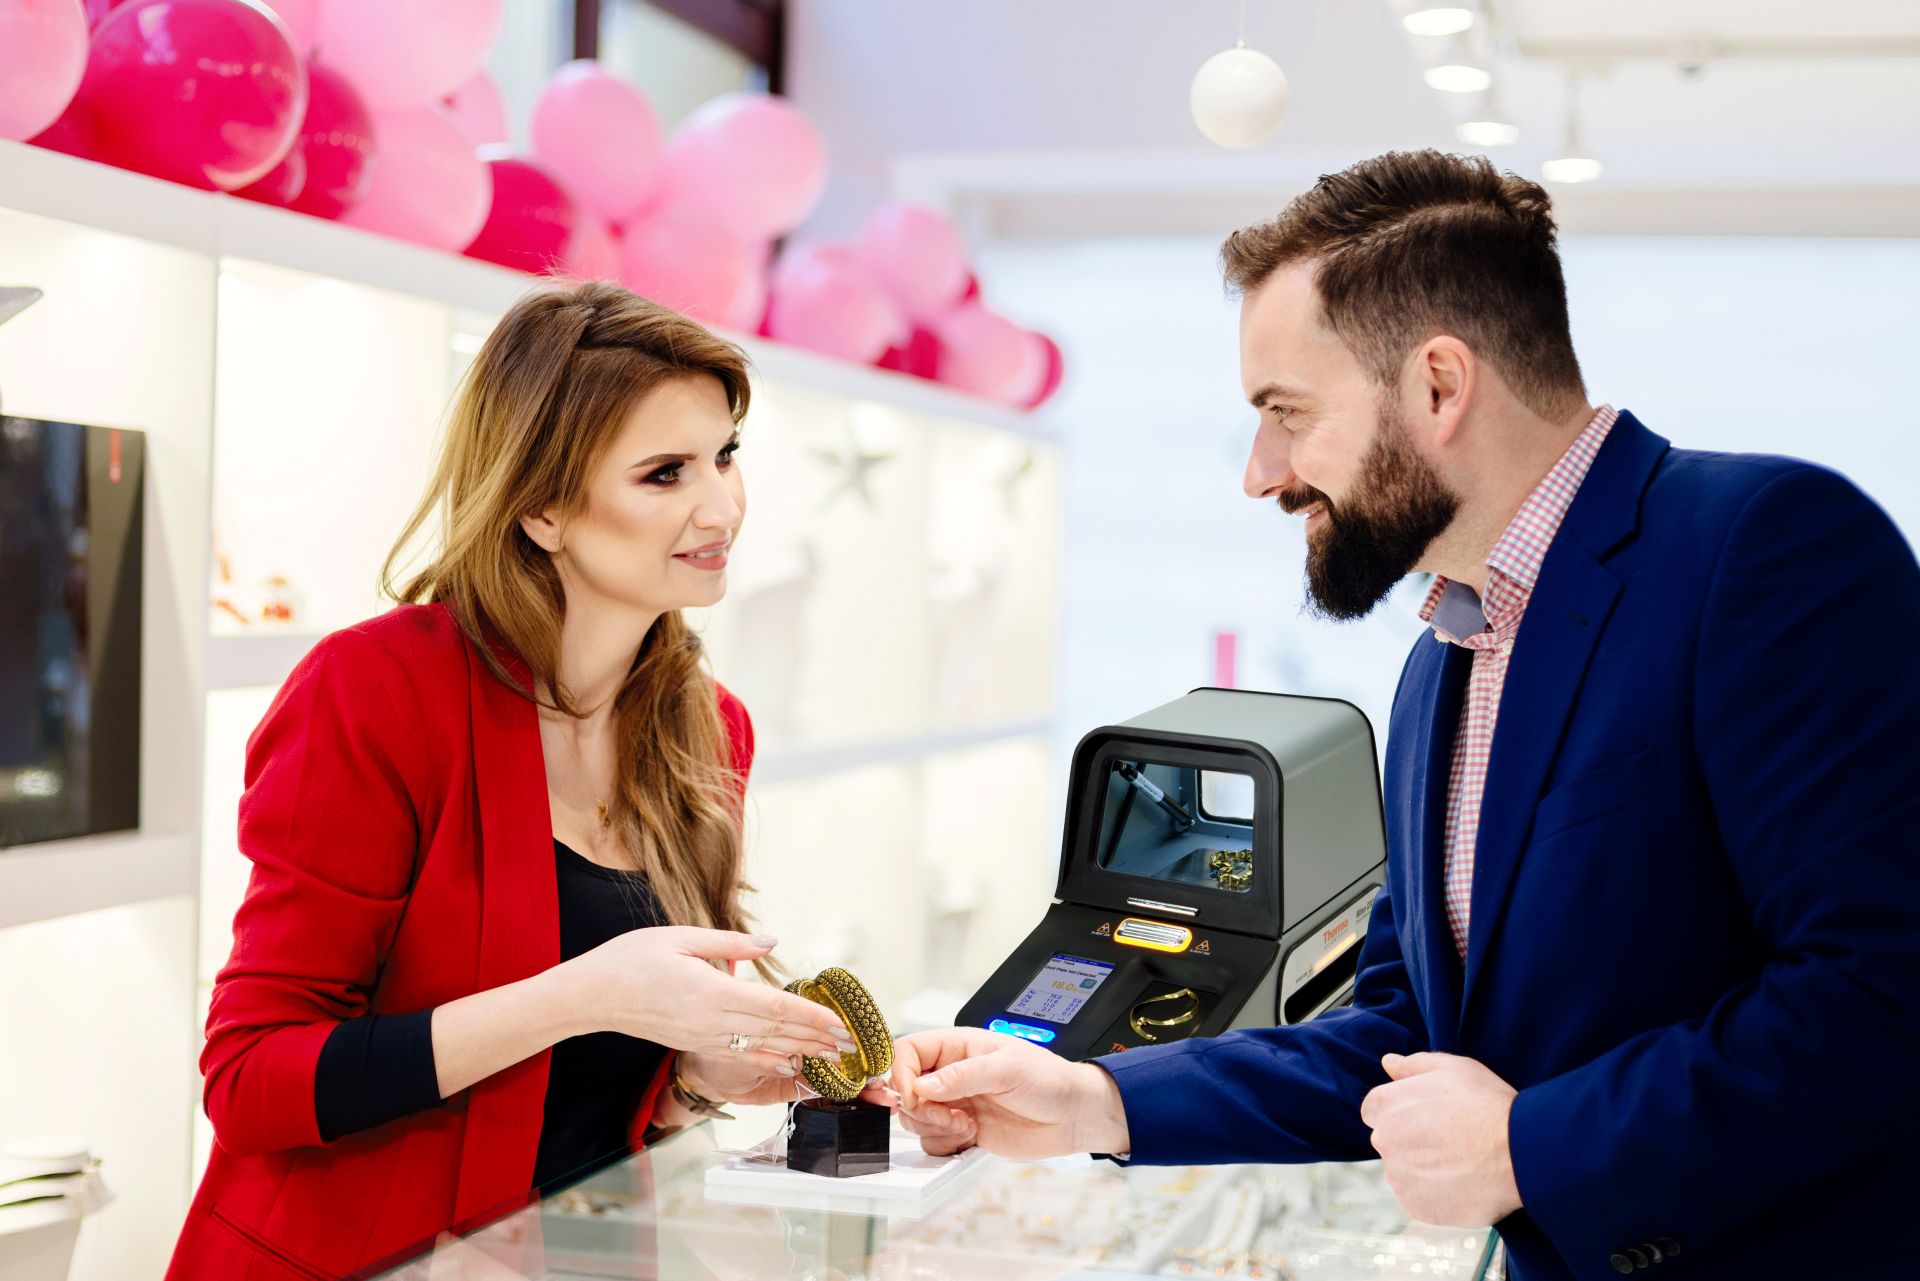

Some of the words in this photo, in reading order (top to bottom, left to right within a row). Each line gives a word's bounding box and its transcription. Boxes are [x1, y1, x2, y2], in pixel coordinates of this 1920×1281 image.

[1323, 919, 1349, 944] Thermo
[1051, 980, 1074, 991] 18.0
[1112, 1042, 1129, 1052] Th
